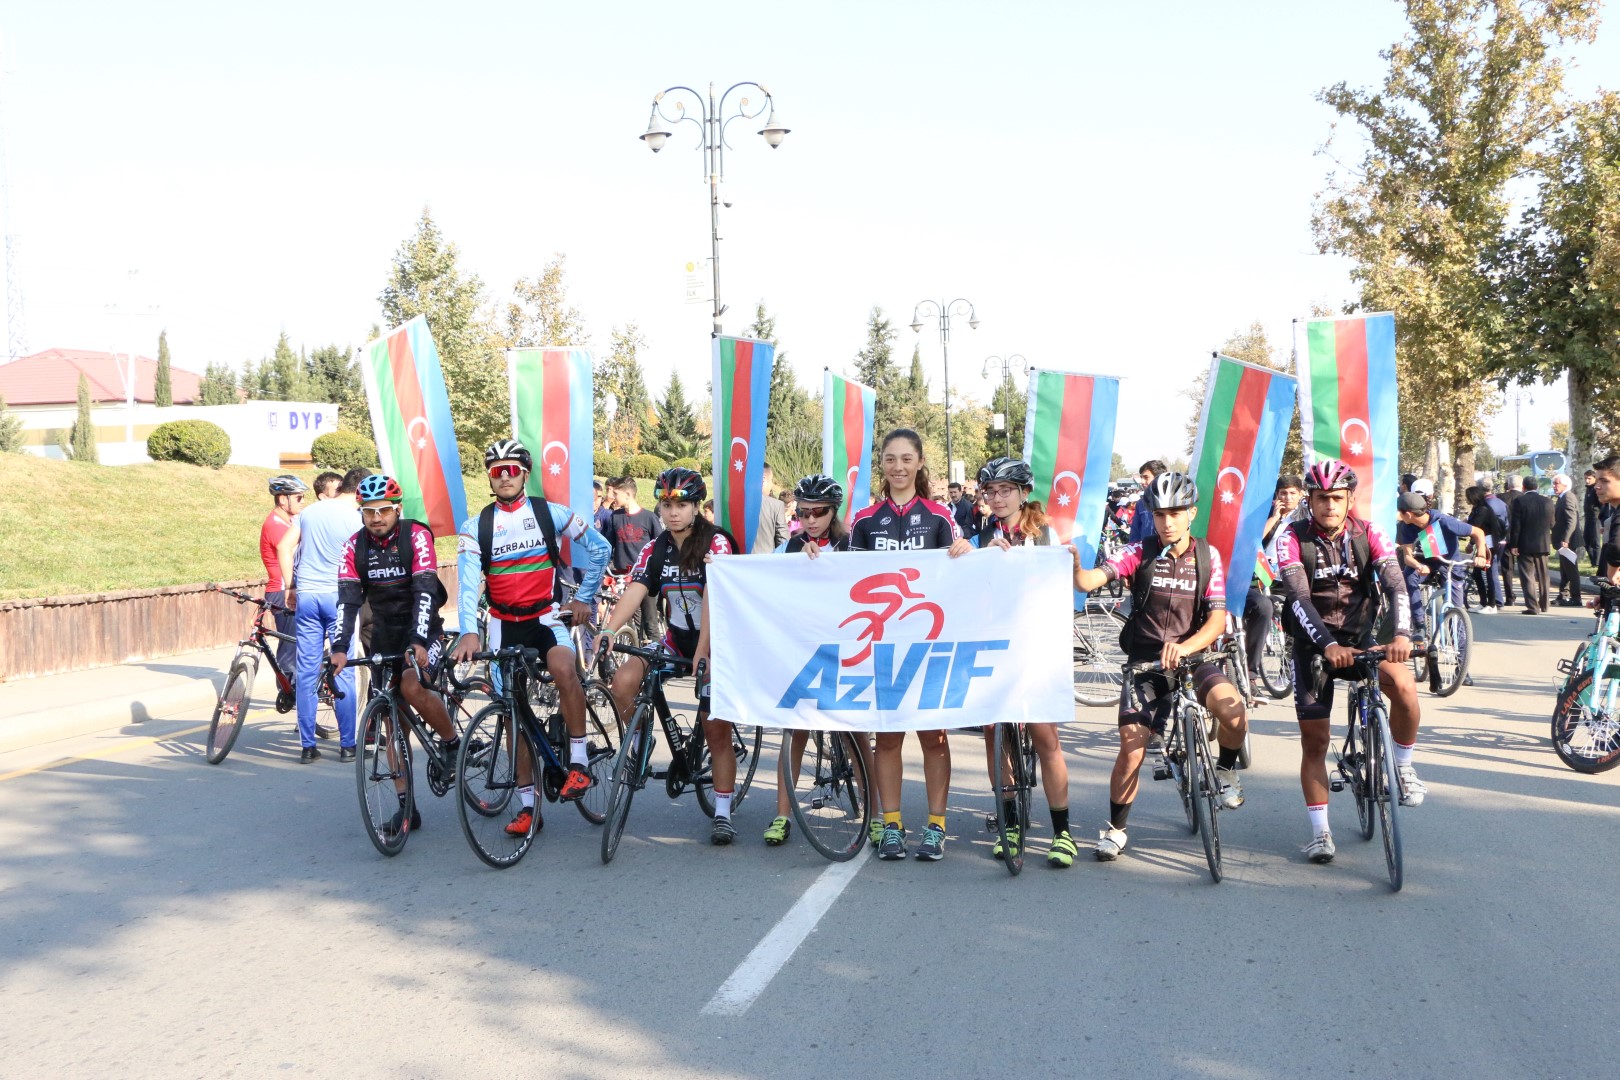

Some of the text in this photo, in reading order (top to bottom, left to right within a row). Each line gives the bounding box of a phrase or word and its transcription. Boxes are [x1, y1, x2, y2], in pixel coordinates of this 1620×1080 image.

[289, 412, 323, 430] DYP
[874, 535, 925, 551] BAKU
[367, 566, 407, 580] BAKU
[1152, 576, 1197, 592] BAKU
[416, 592, 432, 639] BAKU
[428, 639, 442, 666] BAKU
